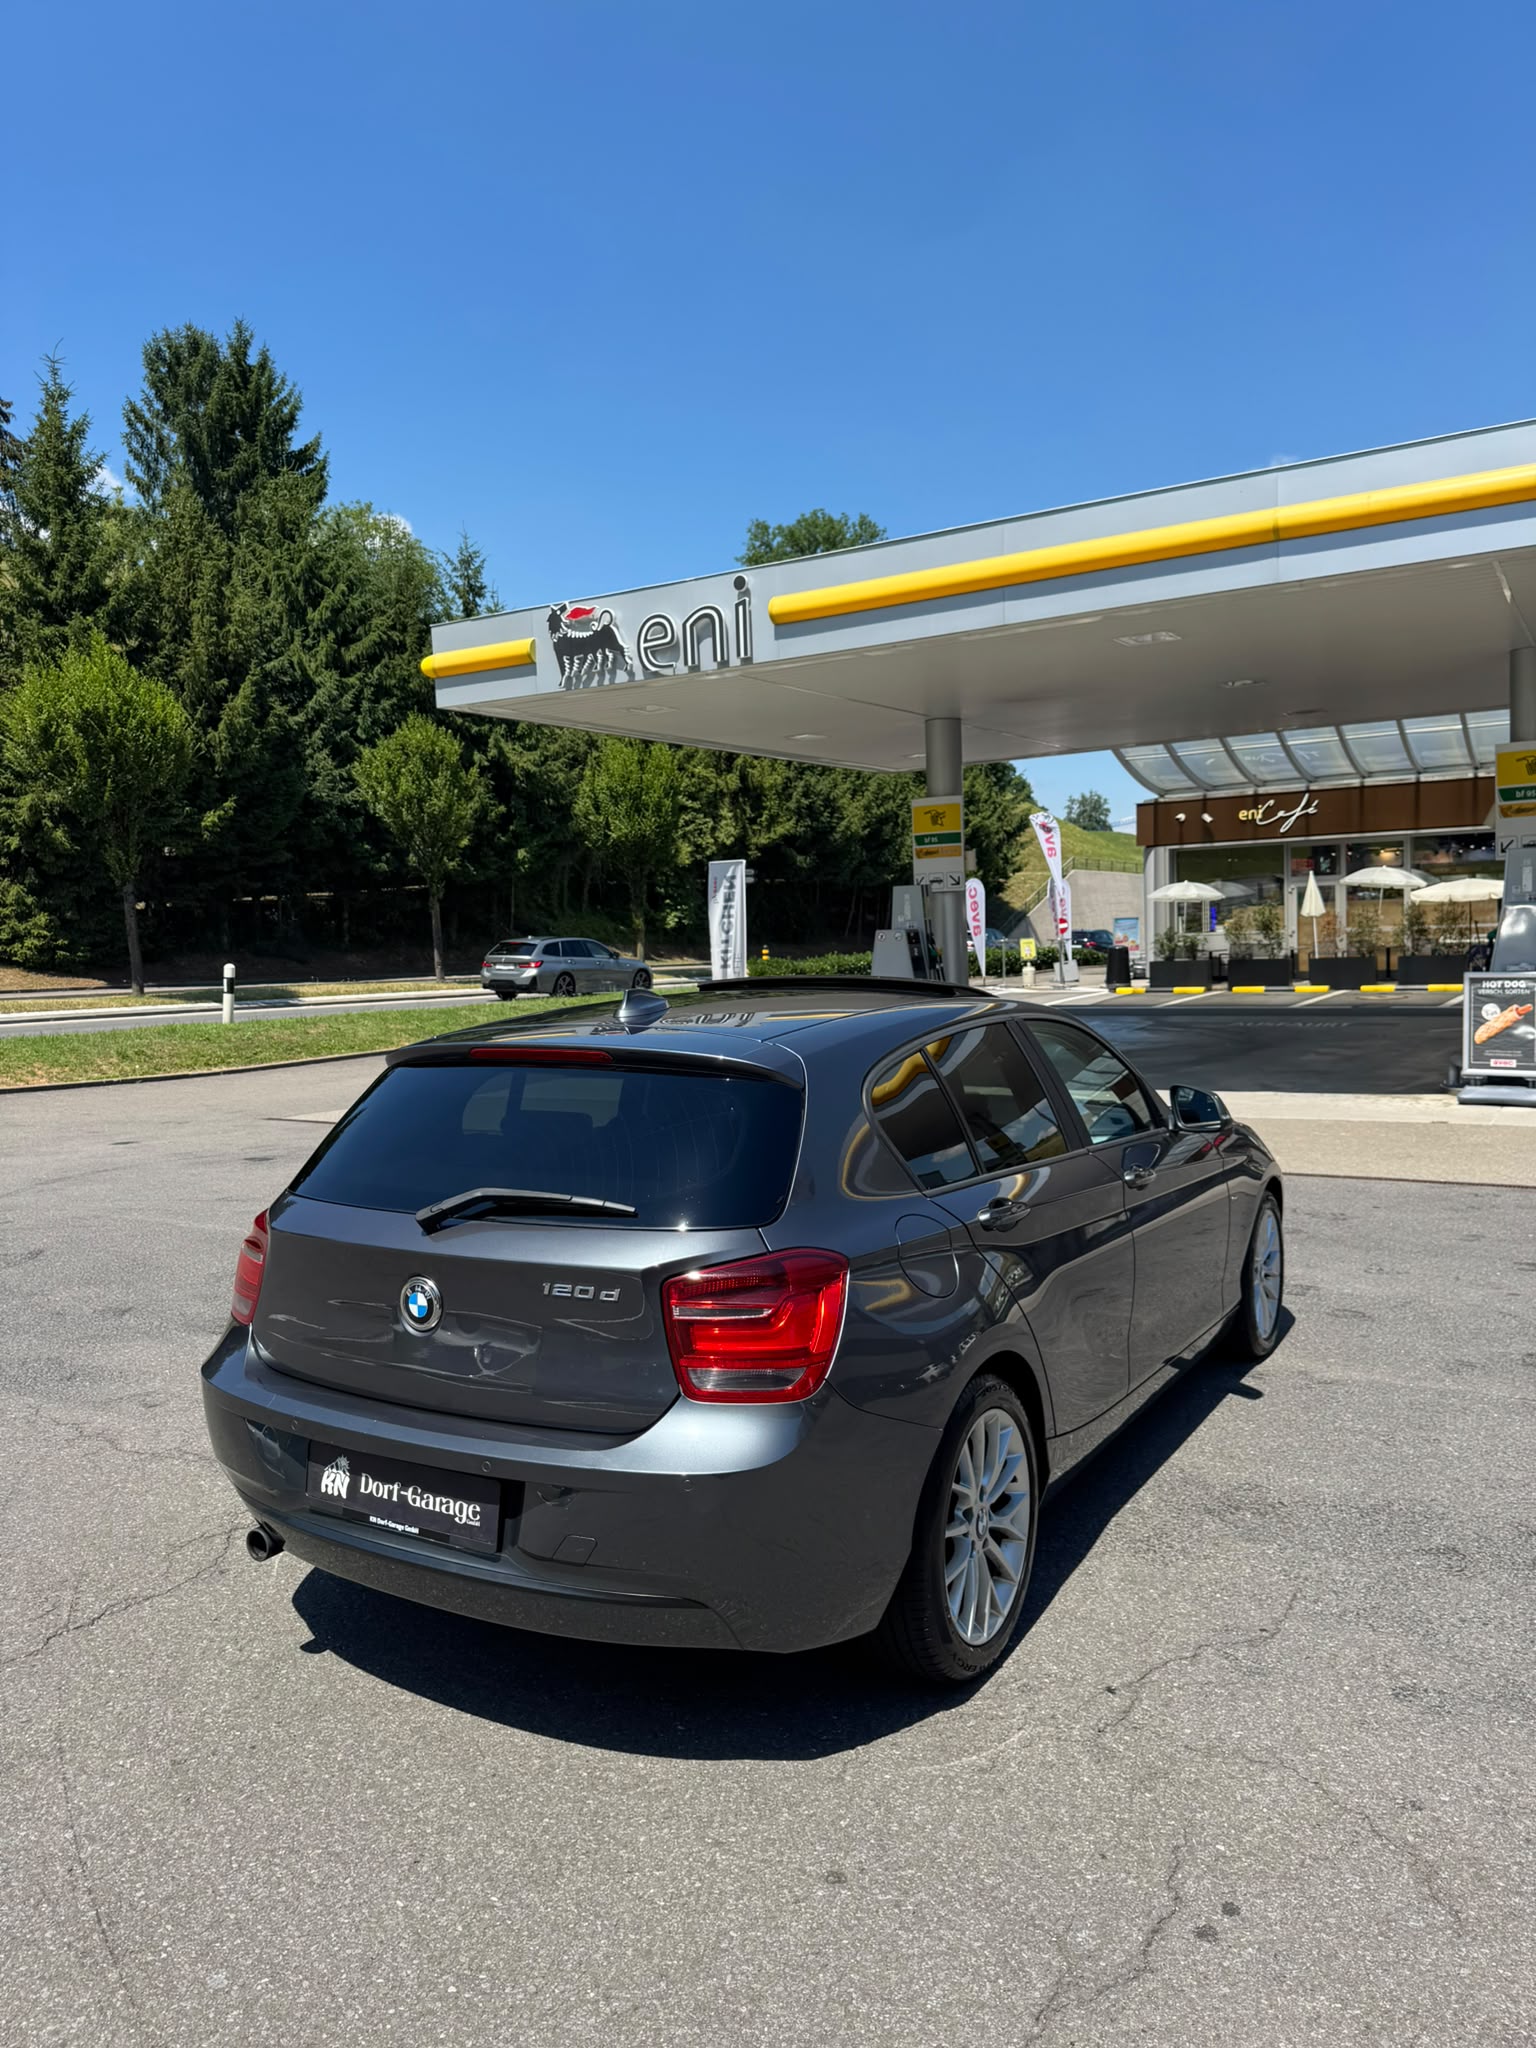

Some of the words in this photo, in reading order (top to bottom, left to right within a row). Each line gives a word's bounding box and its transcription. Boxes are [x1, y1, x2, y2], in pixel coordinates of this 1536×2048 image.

[637, 574, 751, 671] eni
[1238, 804, 1263, 821] eni
[1256, 792, 1319, 833] Café
[1482, 980, 1503, 989] HOT
[1504, 980, 1526, 989] DOG
[320, 1469, 351, 1500] KN
[360, 1472, 481, 1524] Dorf-Garage
